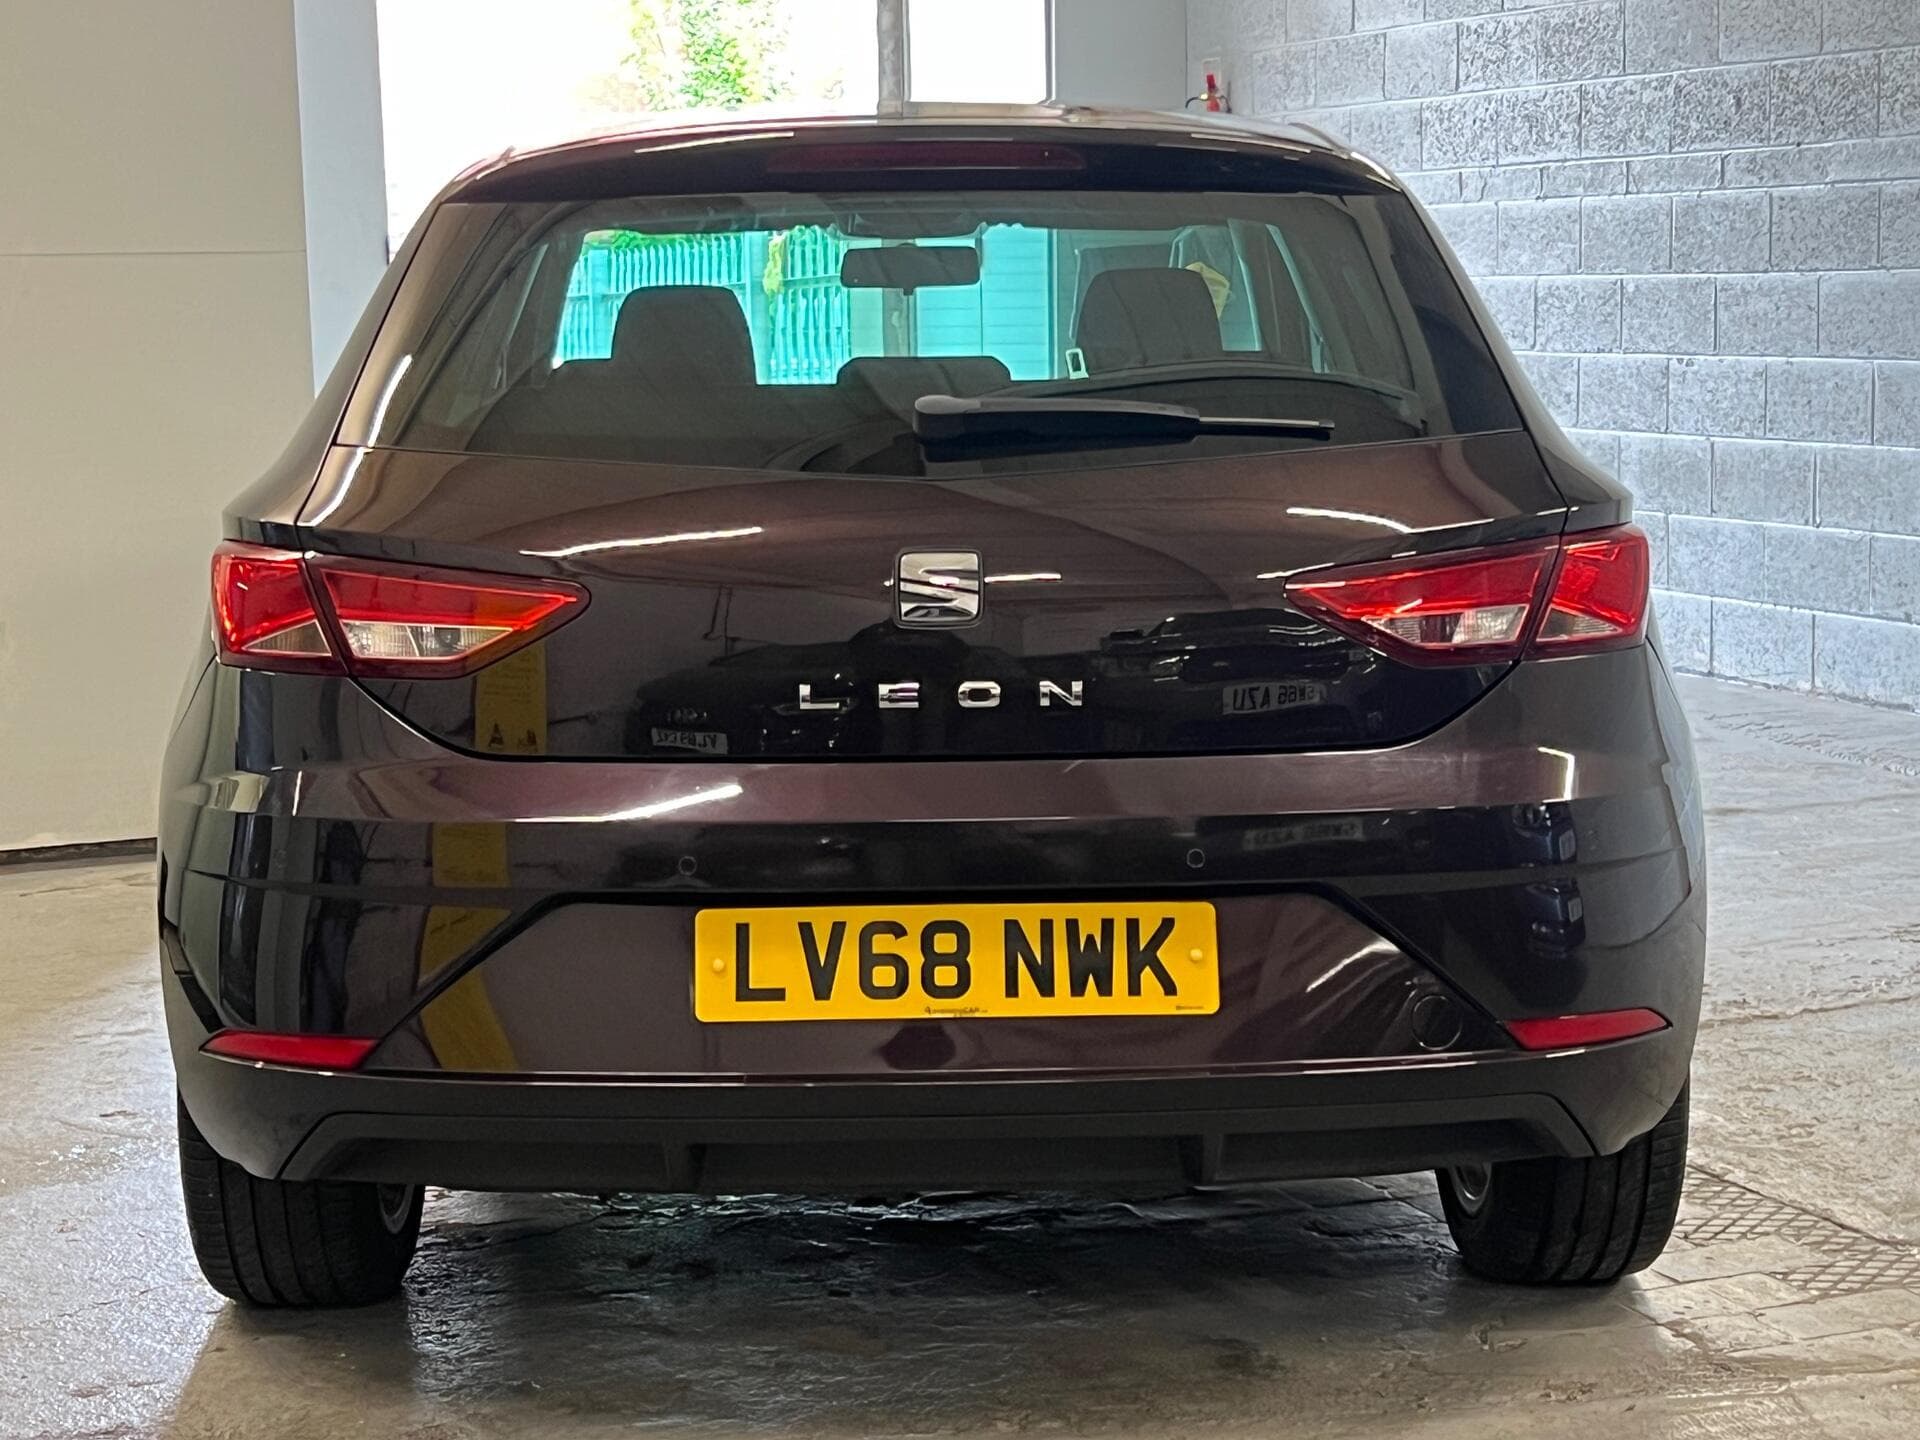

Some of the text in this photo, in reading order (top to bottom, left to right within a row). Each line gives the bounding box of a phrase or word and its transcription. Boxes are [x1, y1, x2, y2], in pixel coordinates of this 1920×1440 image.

[799, 680, 1083, 709] LEON
[735, 917, 1178, 1002] LV68 NWK
